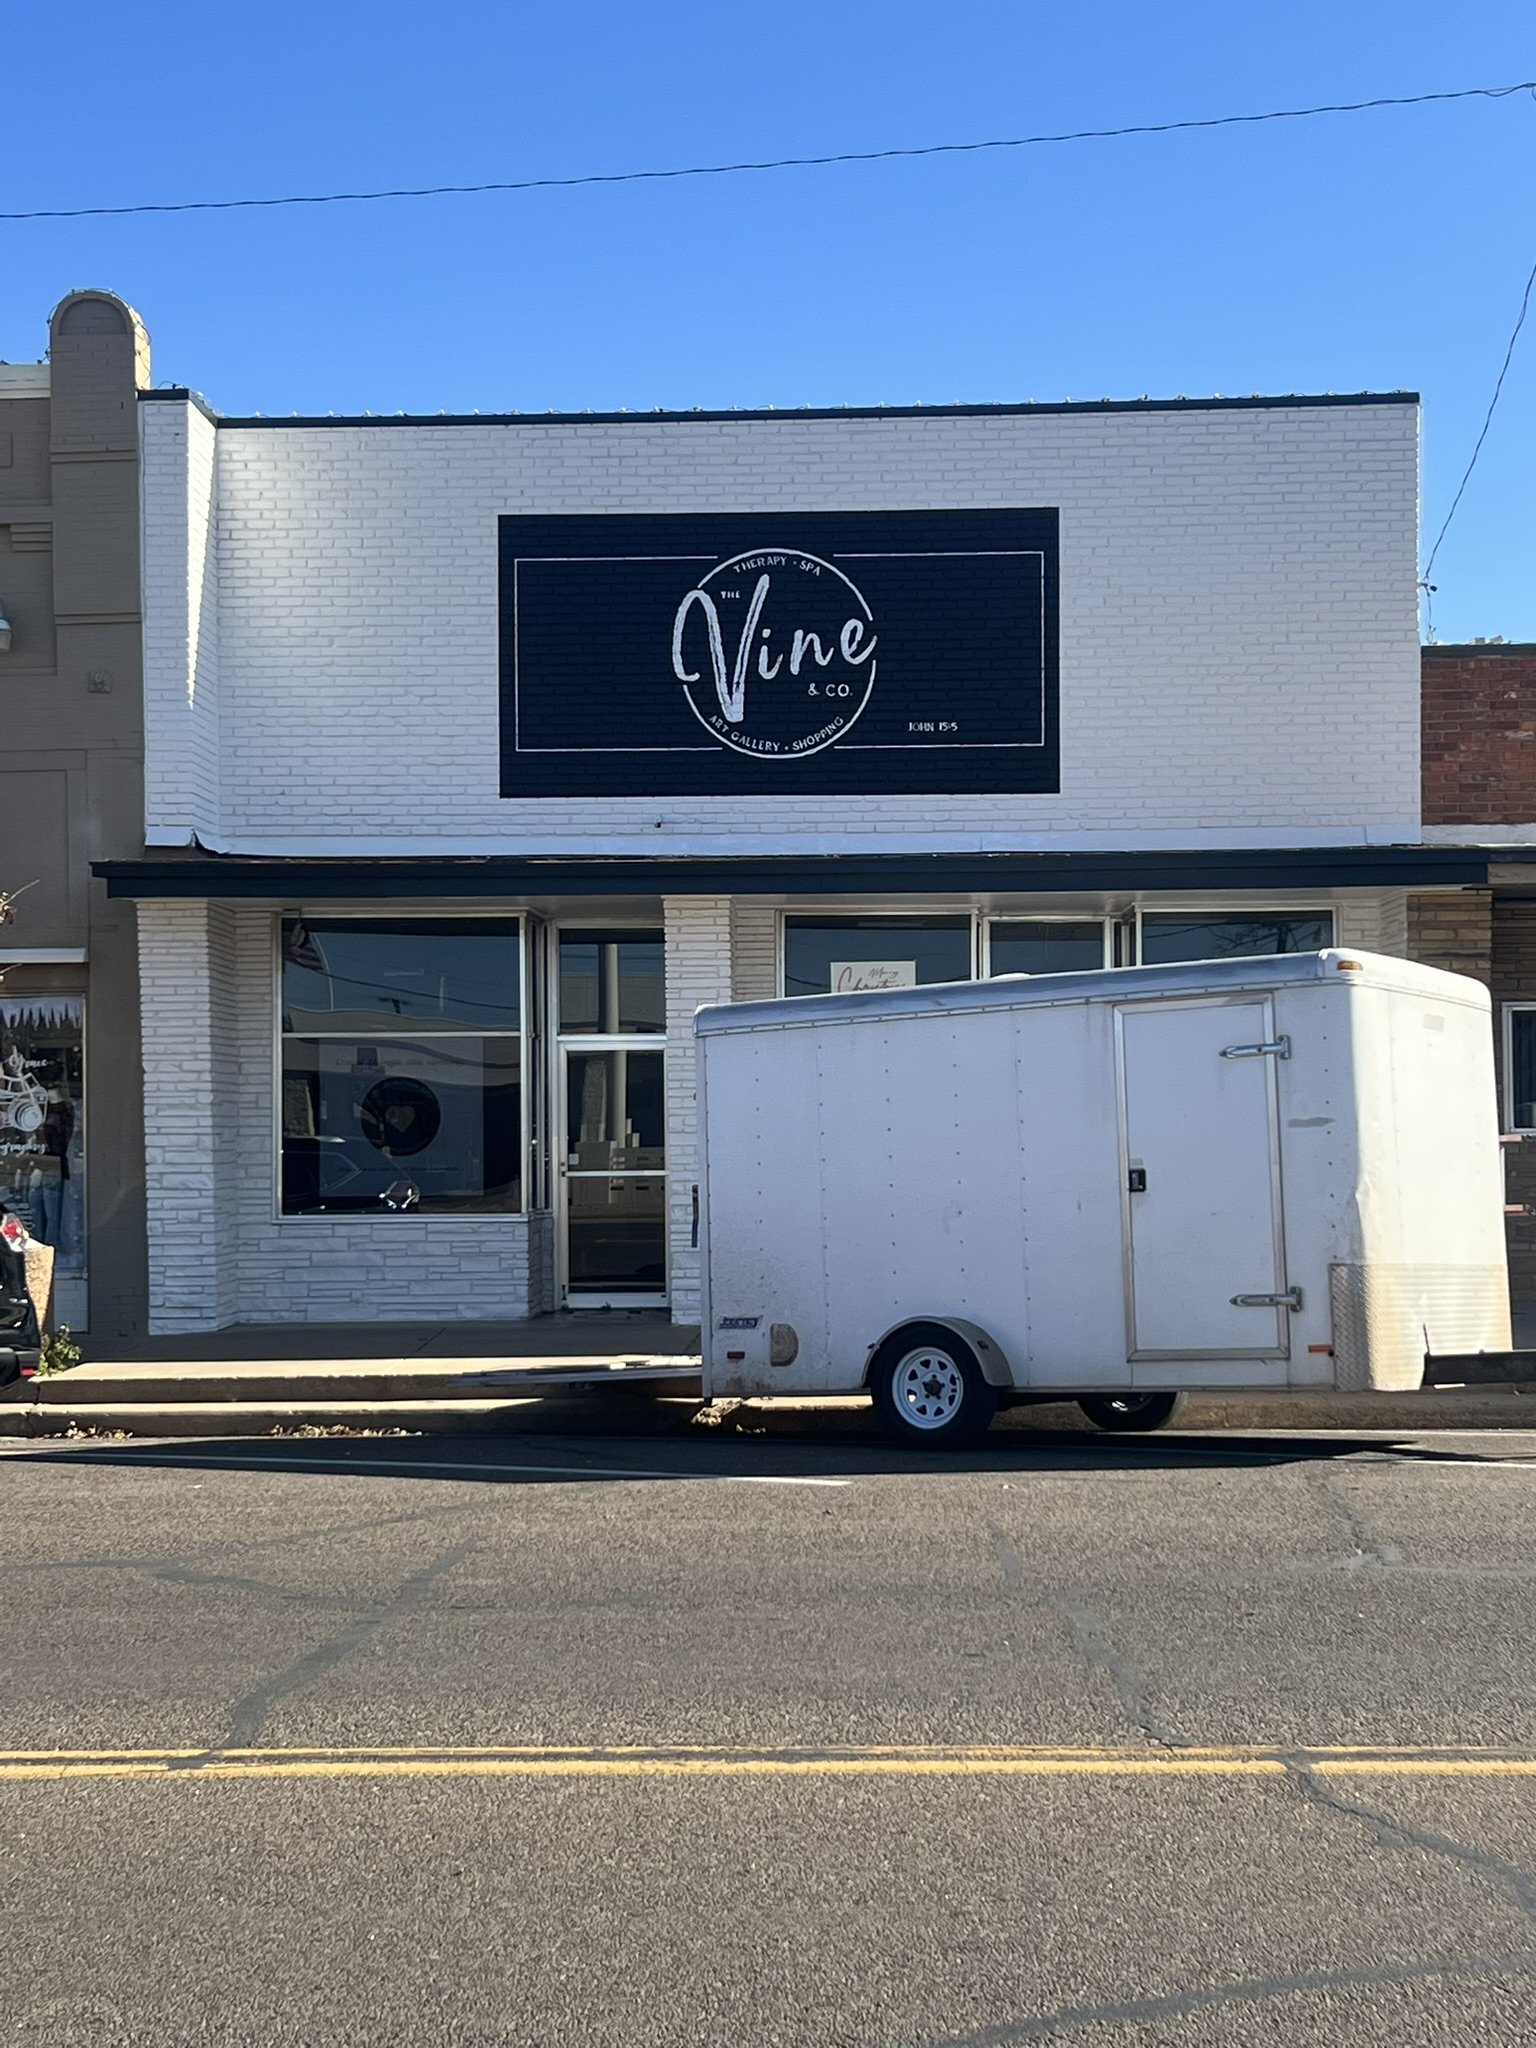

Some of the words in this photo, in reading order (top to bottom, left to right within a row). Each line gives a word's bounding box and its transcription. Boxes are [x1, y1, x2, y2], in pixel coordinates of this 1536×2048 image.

[732, 555, 788, 574] THERAPY
[799, 560, 822, 576] SPA
[720, 590, 741, 600] THE
[671, 573, 878, 723] Vine
[807, 682, 821, 696] &
[708, 714, 729, 733] ART
[730, 731, 781, 752] GALLERY
[792, 716, 845, 751] SHOPPING
[908, 721, 935, 732] JOHN
